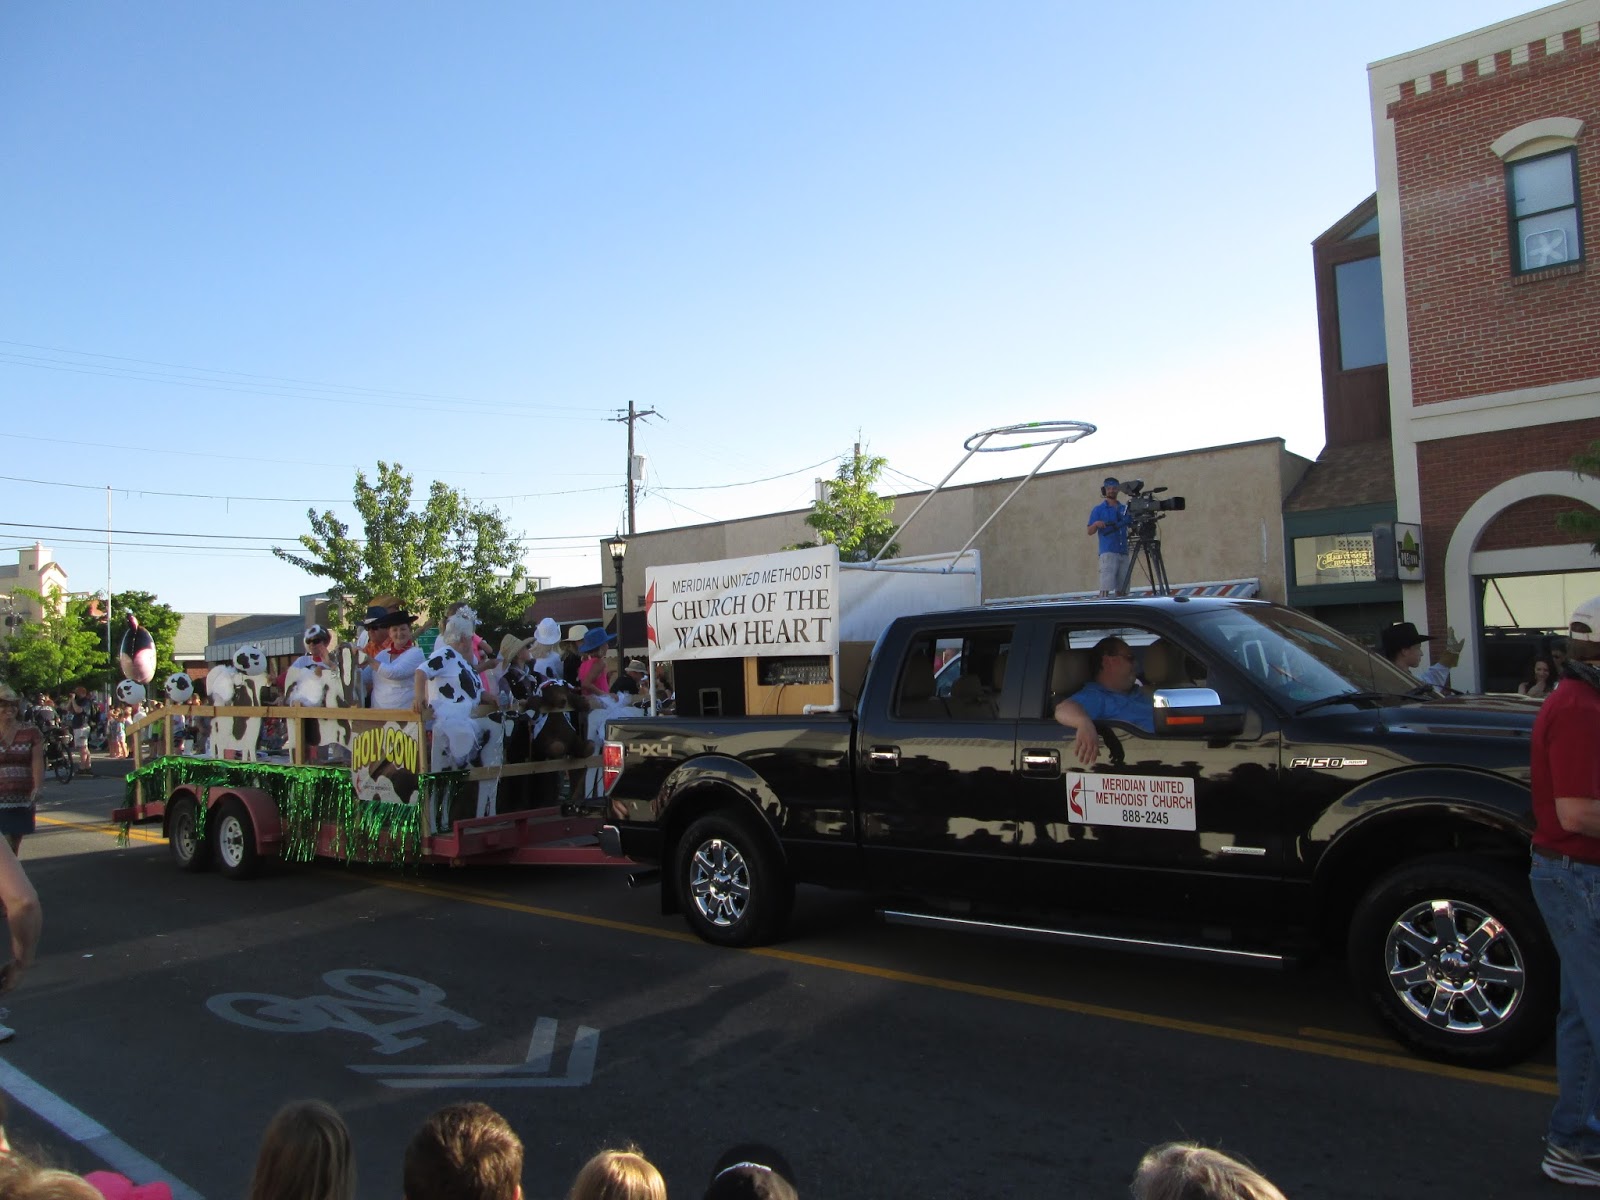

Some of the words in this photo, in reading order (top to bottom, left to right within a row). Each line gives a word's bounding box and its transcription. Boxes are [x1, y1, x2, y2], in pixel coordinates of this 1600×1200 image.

[672, 576, 719, 594] MERIDIAN
[722, 572, 760, 589] UNITED
[761, 564, 831, 584] METHODIST
[672, 595, 746, 621] CHURCH
[751, 592, 777, 614] OF
[783, 589, 830, 611] THE
[673, 621, 738, 649] WARM
[743, 617, 832, 645] HEART
[352, 727, 384, 773] HOLY
[385, 727, 417, 774] COW
[1095, 792, 1148, 807] METHODIST
[1152, 795, 1193, 809] CHURCH
[1102, 778, 1145, 792] MERIDIAN
[1150, 780, 1184, 794] UNITED
[1122, 809, 1169, 825] 888-2245
